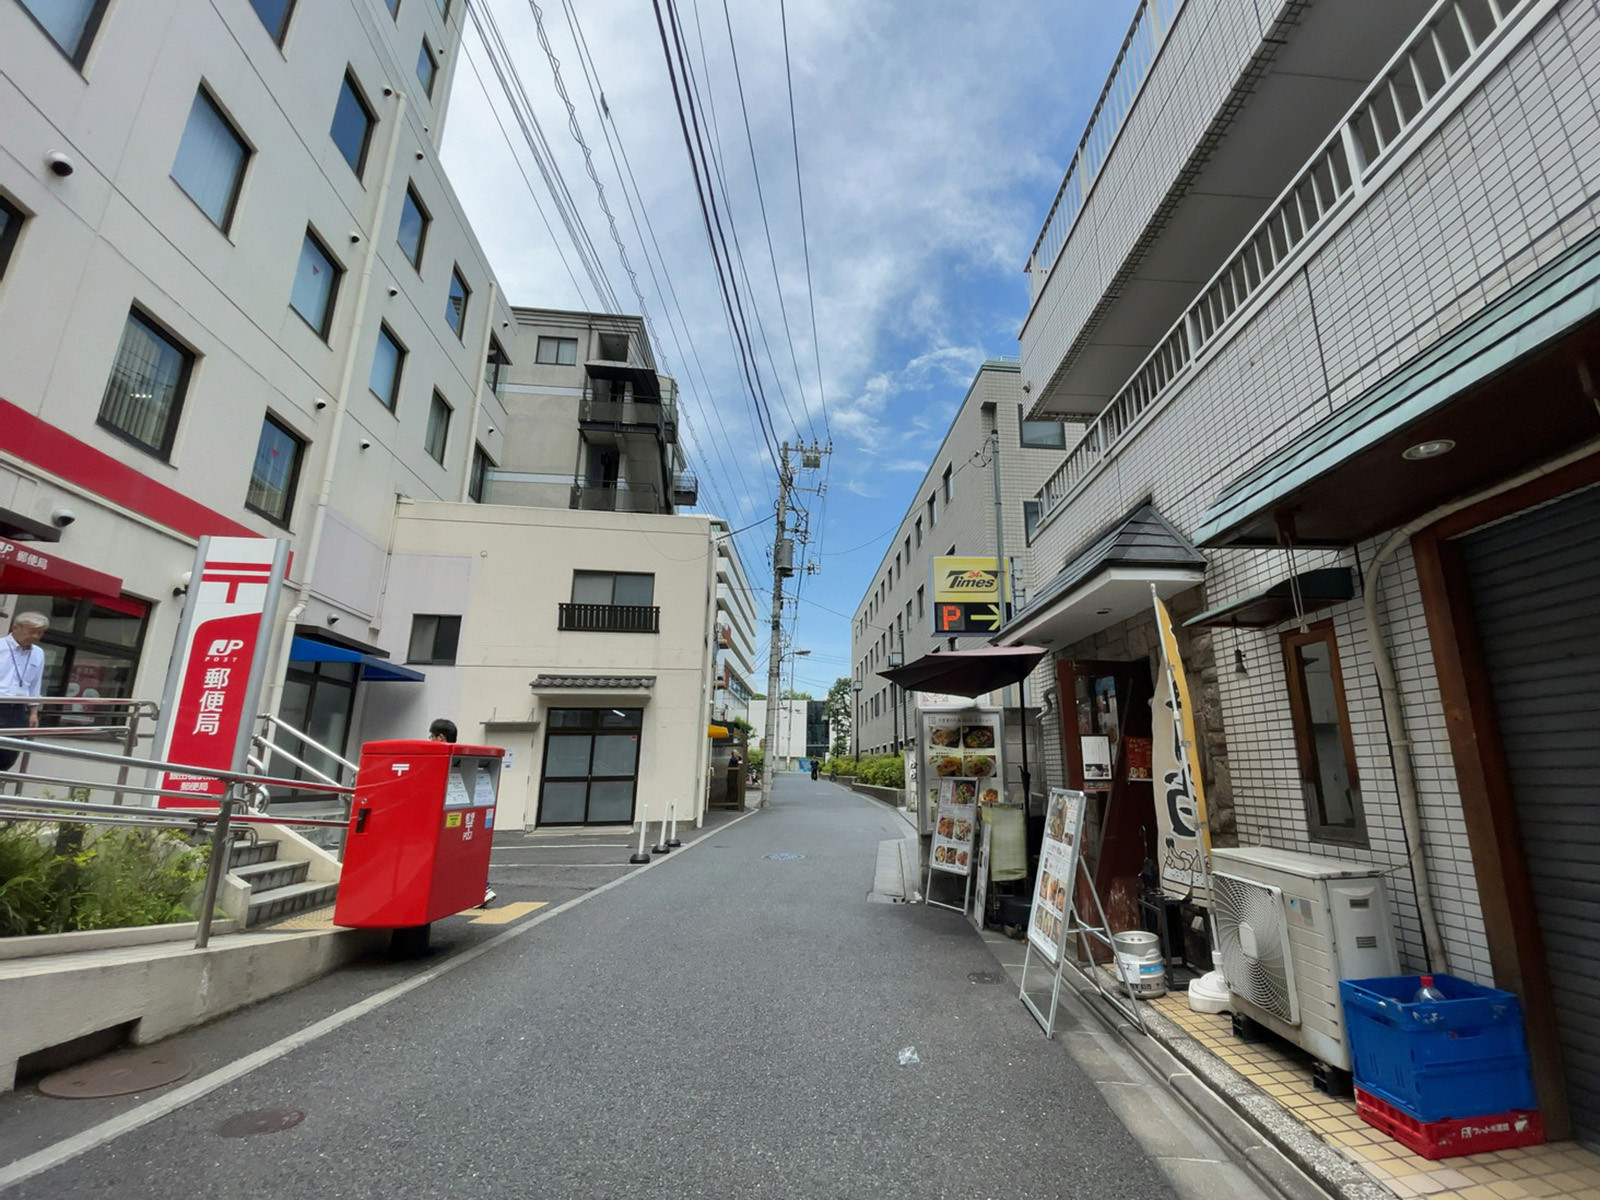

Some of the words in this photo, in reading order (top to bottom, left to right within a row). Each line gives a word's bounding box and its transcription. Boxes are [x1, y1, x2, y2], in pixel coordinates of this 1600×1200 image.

[946, 570, 998, 589] Times
[943, 605, 961, 631] P
[207, 639, 244, 656] JP
[192, 667, 231, 736] 郵便局
